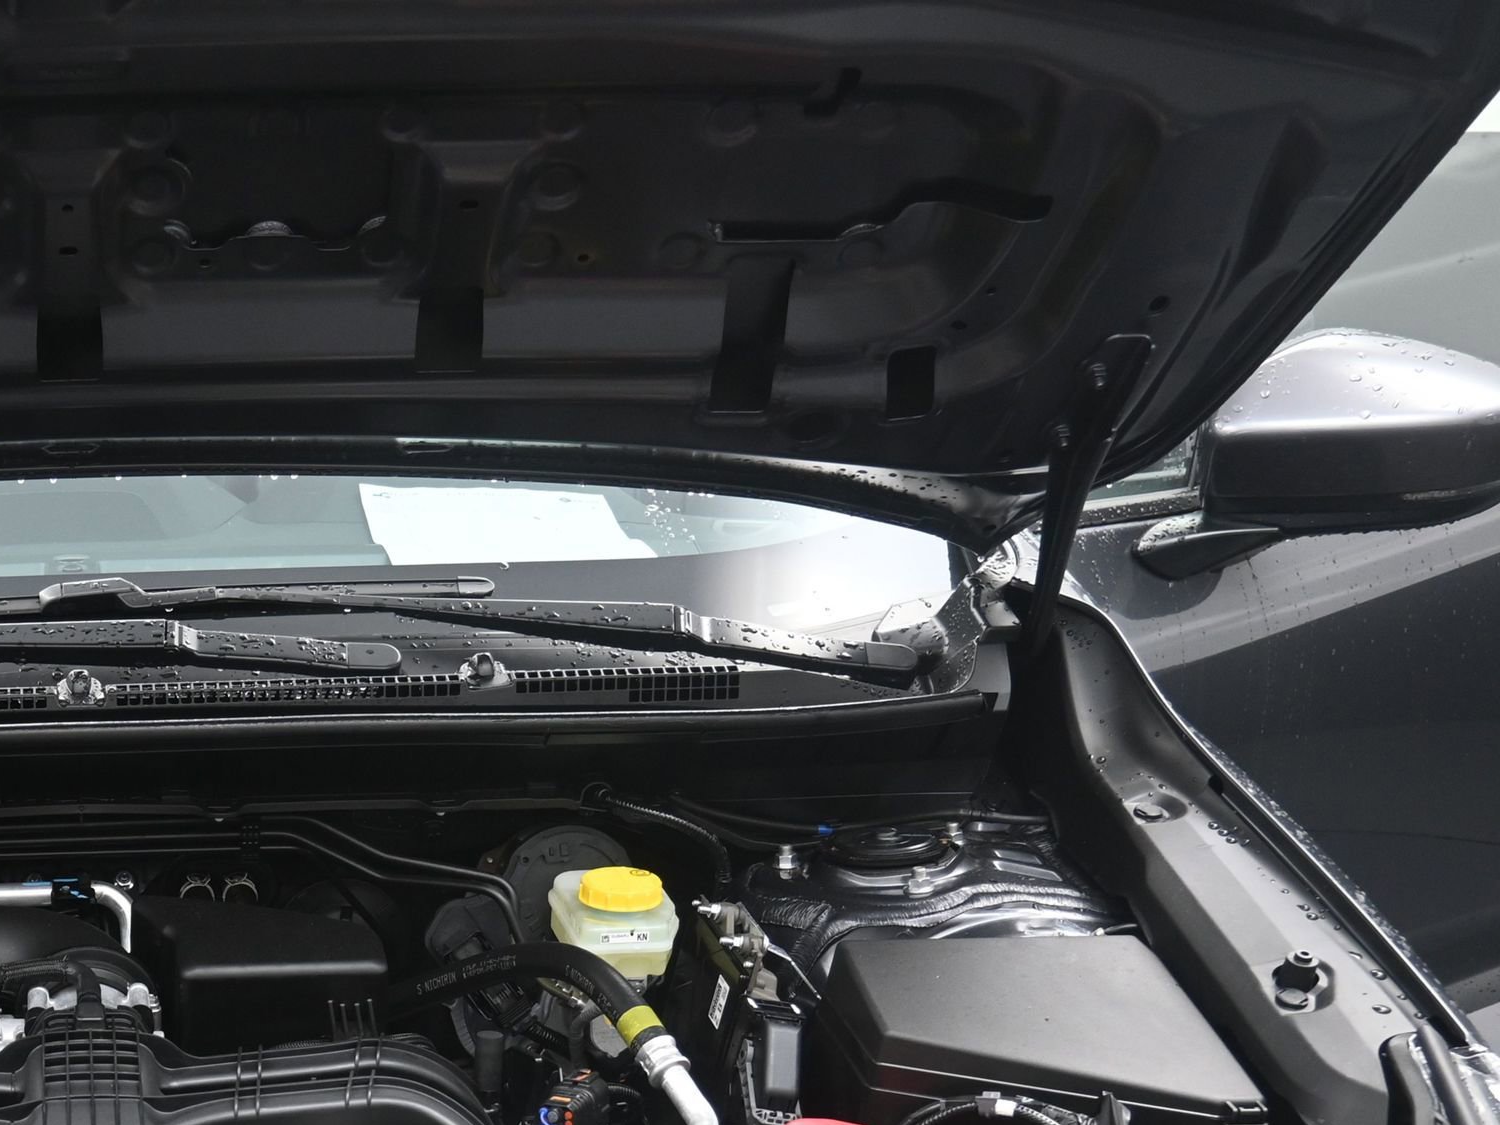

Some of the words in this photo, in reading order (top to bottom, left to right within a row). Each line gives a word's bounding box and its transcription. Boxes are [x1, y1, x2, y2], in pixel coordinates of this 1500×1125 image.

[636, 932, 648, 941] KN
[416, 983, 423, 995] S
[424, 971, 457, 993] NICHIRIN
